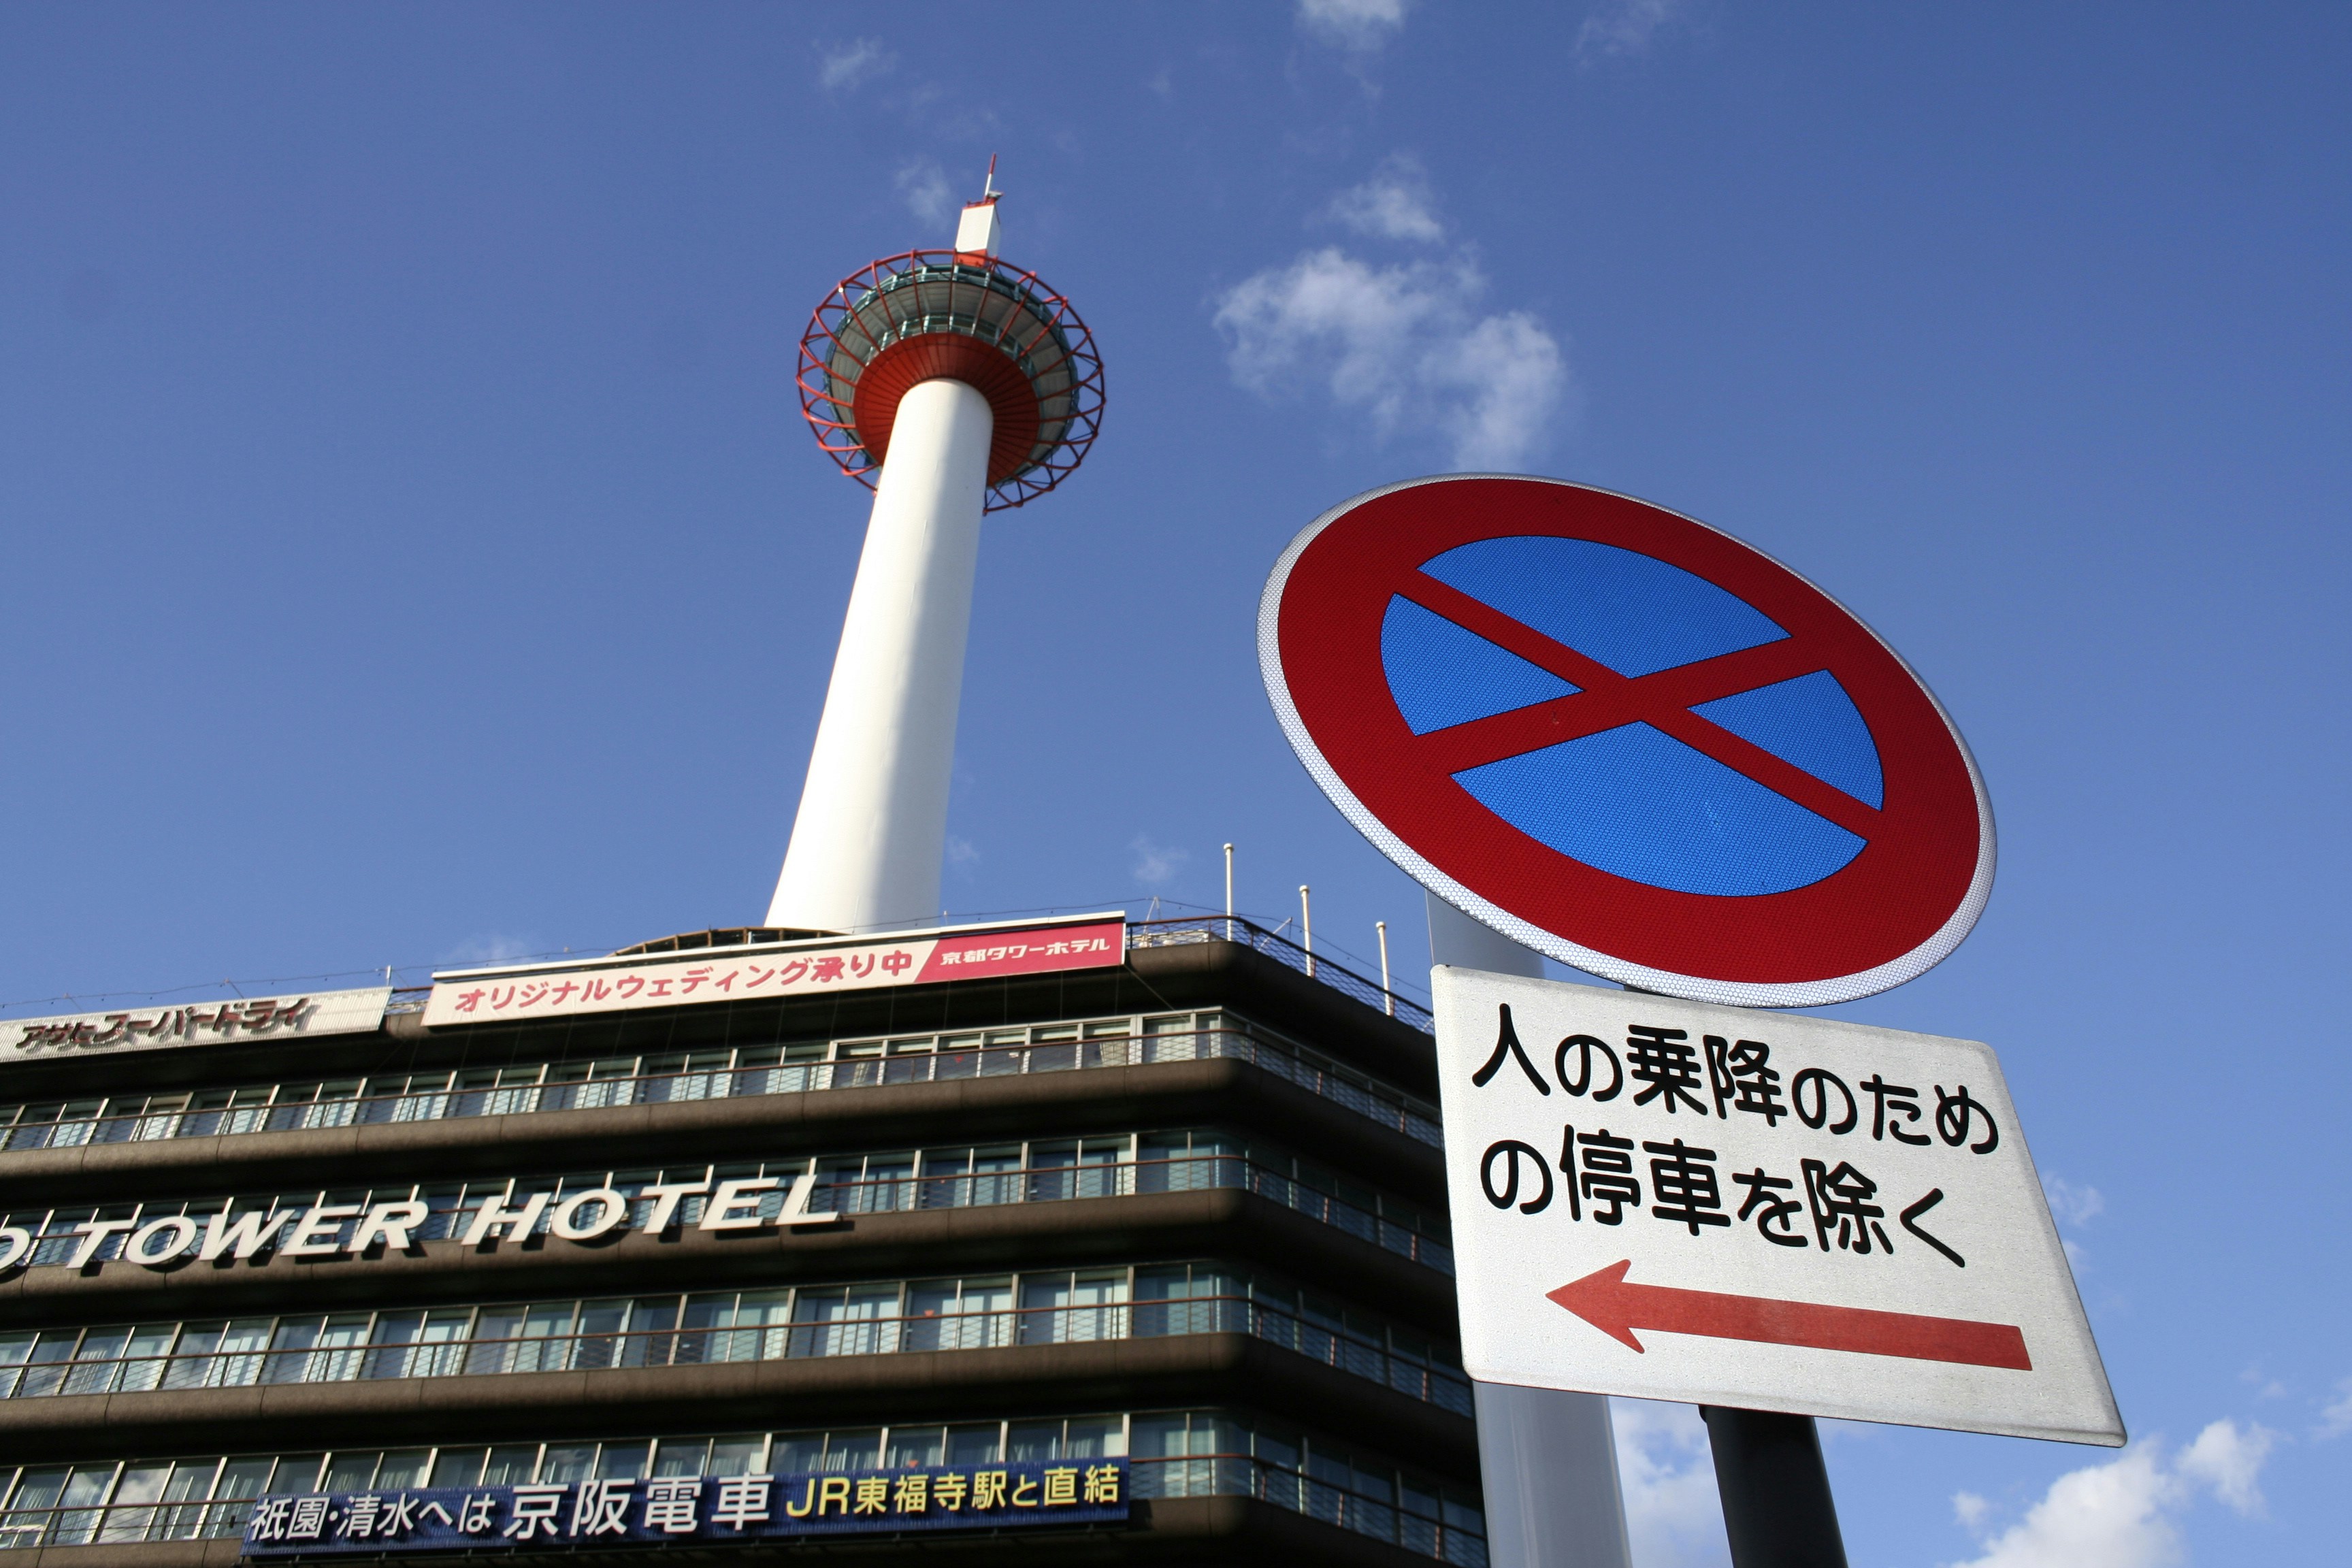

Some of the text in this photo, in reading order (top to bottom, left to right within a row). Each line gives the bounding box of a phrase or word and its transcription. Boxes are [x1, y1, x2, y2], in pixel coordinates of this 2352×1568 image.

[455, 949, 913, 1012] オリジナルウェディング承り中
[940, 938, 1111, 966] 京都タワーホテル
[1471, 1002, 1999, 1155] 人の乗降のため
[66, 1200, 429, 1269] TOWER
[461, 1174, 840, 1245] HOTEL
[1480, 1124, 1966, 1268] の停車を除く
